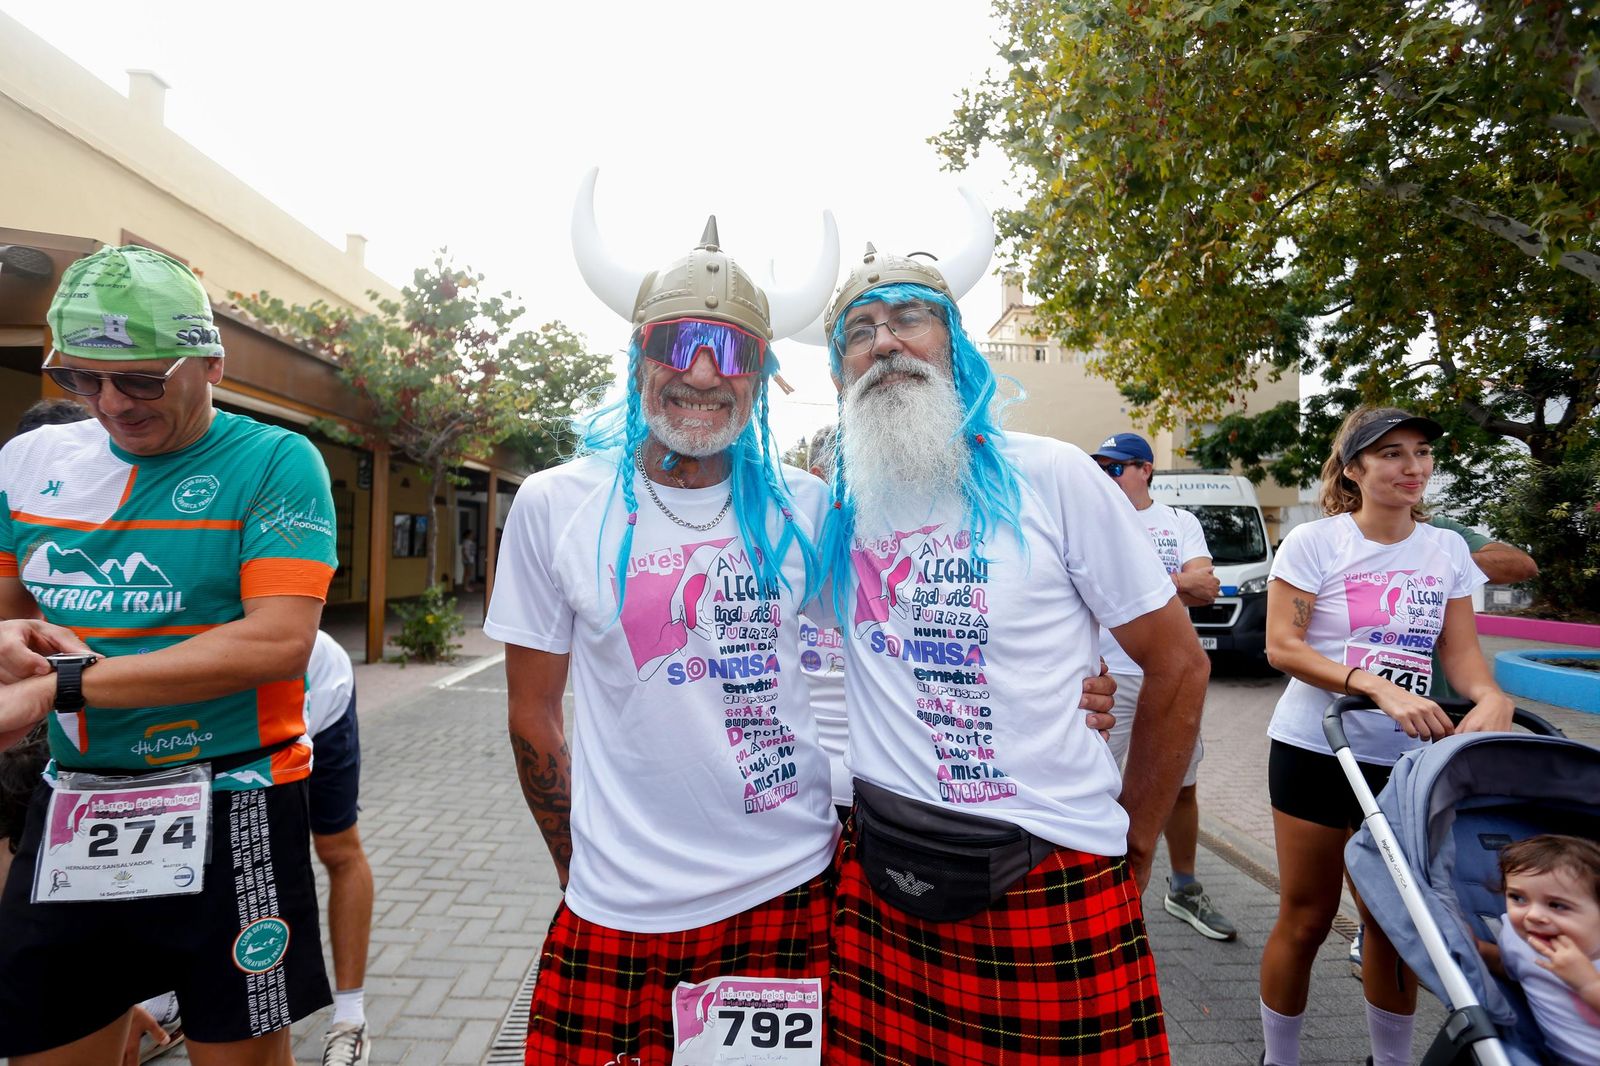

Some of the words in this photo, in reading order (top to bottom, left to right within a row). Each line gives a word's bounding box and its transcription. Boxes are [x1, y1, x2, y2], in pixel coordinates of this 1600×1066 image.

[608, 551, 683, 573] lores
[1344, 571, 1387, 583] valores
[1407, 575, 1443, 590] AMOR
[26, 585, 113, 612] RAFRICA
[122, 591, 186, 613] TRAIL
[912, 605, 989, 628] FUERZA
[1409, 616, 1441, 629] FUERZ
[715, 624, 778, 640] FUERZA
[914, 627, 988, 645] HUMILDAD
[871, 631, 986, 667] SONRISA
[667, 654, 781, 686] SONRISA
[917, 682, 990, 699] altruismo
[1378, 668, 1428, 695] 445
[723, 693, 779, 704] altrismo
[735, 734, 796, 764] COLABORAR
[240, 809, 250, 828] TRAIL
[249, 807, 260, 842] EURAFRICA
[88, 816, 196, 858] 274
[229, 812, 241, 848] EURAFRICA
[232, 849, 243, 869] TRAIL
[253, 843, 262, 863] TRAIL
[263, 862, 276, 883] TRAIL
[254, 867, 268, 904] EURAFRICA
[247, 973, 257, 994] TRAIL
[258, 991, 270, 1011] TRAIL
[268, 987, 281, 1025] EURAFRICA
[786, 991, 818, 1004] valores
[248, 994, 260, 1031] EURAFRICA
[718, 1010, 813, 1049] 792
